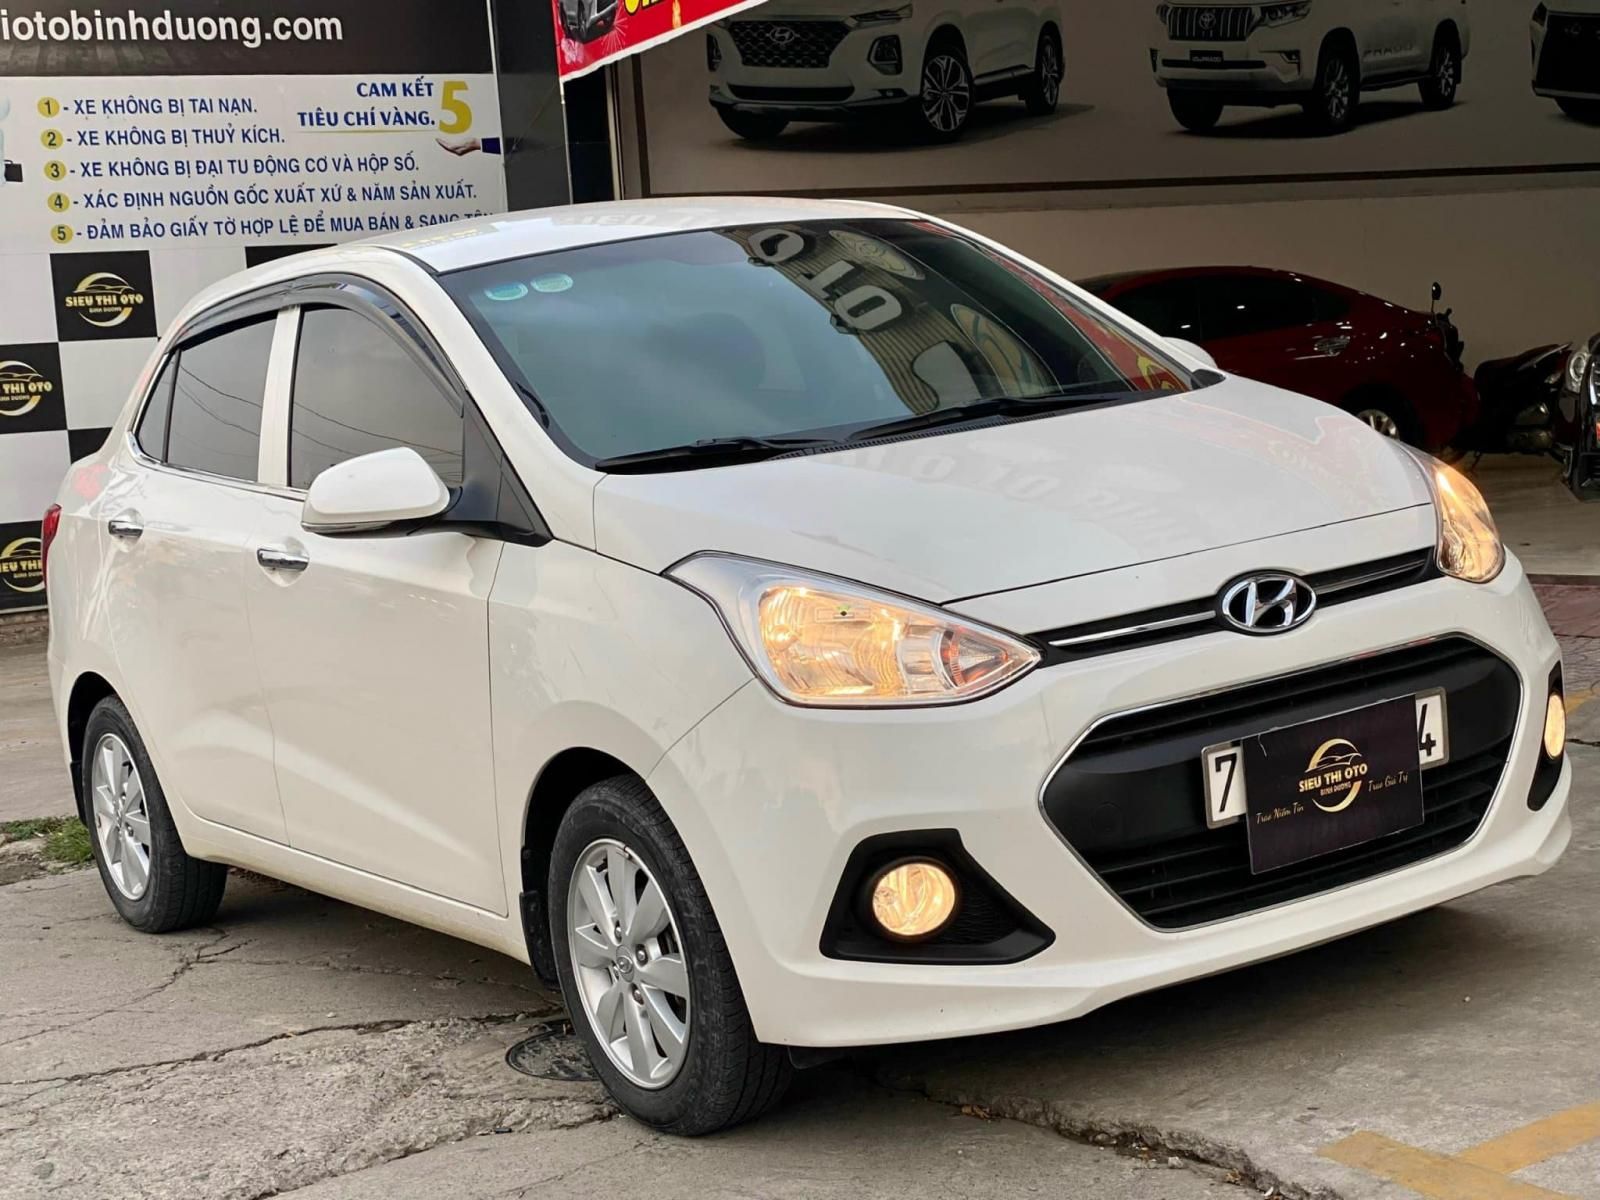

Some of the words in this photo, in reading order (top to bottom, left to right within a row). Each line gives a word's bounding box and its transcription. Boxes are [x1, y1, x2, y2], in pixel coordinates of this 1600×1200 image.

[0, 9, 343, 48] iotobinhduong.com
[356, 82, 396, 97] CAM
[402, 76, 433, 97] KẾT
[74, 100, 96, 115] XE
[102, 95, 163, 115] KHÔNG
[168, 98, 185, 117] BỊ
[189, 99, 215, 113] TAI
[219, 99, 257, 116] NẠN.
[297, 107, 338, 126] TIÊU
[344, 107, 375, 126] CHÍ
[380, 107, 435, 126] VÀNG.
[439, 80, 472, 134] 5
[47, 132, 57, 146] 2
[77, 131, 99, 146] XE
[105, 126, 165, 146] KHÔNG
[171, 130, 188, 147] BỊ
[192, 122, 235, 145] THUỶ
[241, 124, 285, 144] KÍCH.
[50, 163, 60, 178] 3
[80, 162, 103, 177] XE
[109, 157, 169, 177] KHÔNG
[174, 160, 191, 178] BỊ
[196, 160, 223, 178] ĐẠI
[227, 160, 249, 174] TU
[254, 154, 300, 177] ĐỘNG
[305, 156, 328, 173] CƠ
[332, 154, 353, 172] VÀ
[357, 154, 388, 176] HỘP
[394, 151, 419, 172] SỐ.
[54, 195, 63, 209] 4
[84, 189, 118, 208] XÁC
[124, 192, 164, 210] ĐỊNH
[170, 184, 229, 206] NGUỒN
[234, 183, 269, 205] GỐC
[274, 182, 316, 204] XUẤT
[321, 183, 342, 202] XỨ
[347, 188, 358, 202] &
[362, 183, 395, 201] NĂM
[401, 180, 430, 201] SẢN
[435, 178, 477, 199] XUẤT.
[57, 226, 66, 241] 5
[87, 218, 124, 239] ĐẢM
[130, 217, 165, 238] BẢO
[170, 215, 209, 237] GIẤY
[214, 216, 236, 236] TỜ
[241, 219, 274, 237] HỢP
[279, 215, 299, 236] LỆ
[304, 210, 325, 232] ĐỂ
[330, 218, 364, 232] MUA
[368, 212, 400, 230] BÁN
[405, 216, 414, 229] &
[65, 295, 93, 307] SIEU
[95, 295, 117, 306] THI
[120, 294, 144, 304] OTO
[3, 383, 25, 394] THI
[28, 381, 52, 392] OTO
[1418, 704, 1437, 757] 4
[1215, 753, 1237, 813] 7
[1299, 776, 1322, 793] SIEU
[1324, 770, 1342, 785] THI
[1345, 763, 1368, 779] OTO
